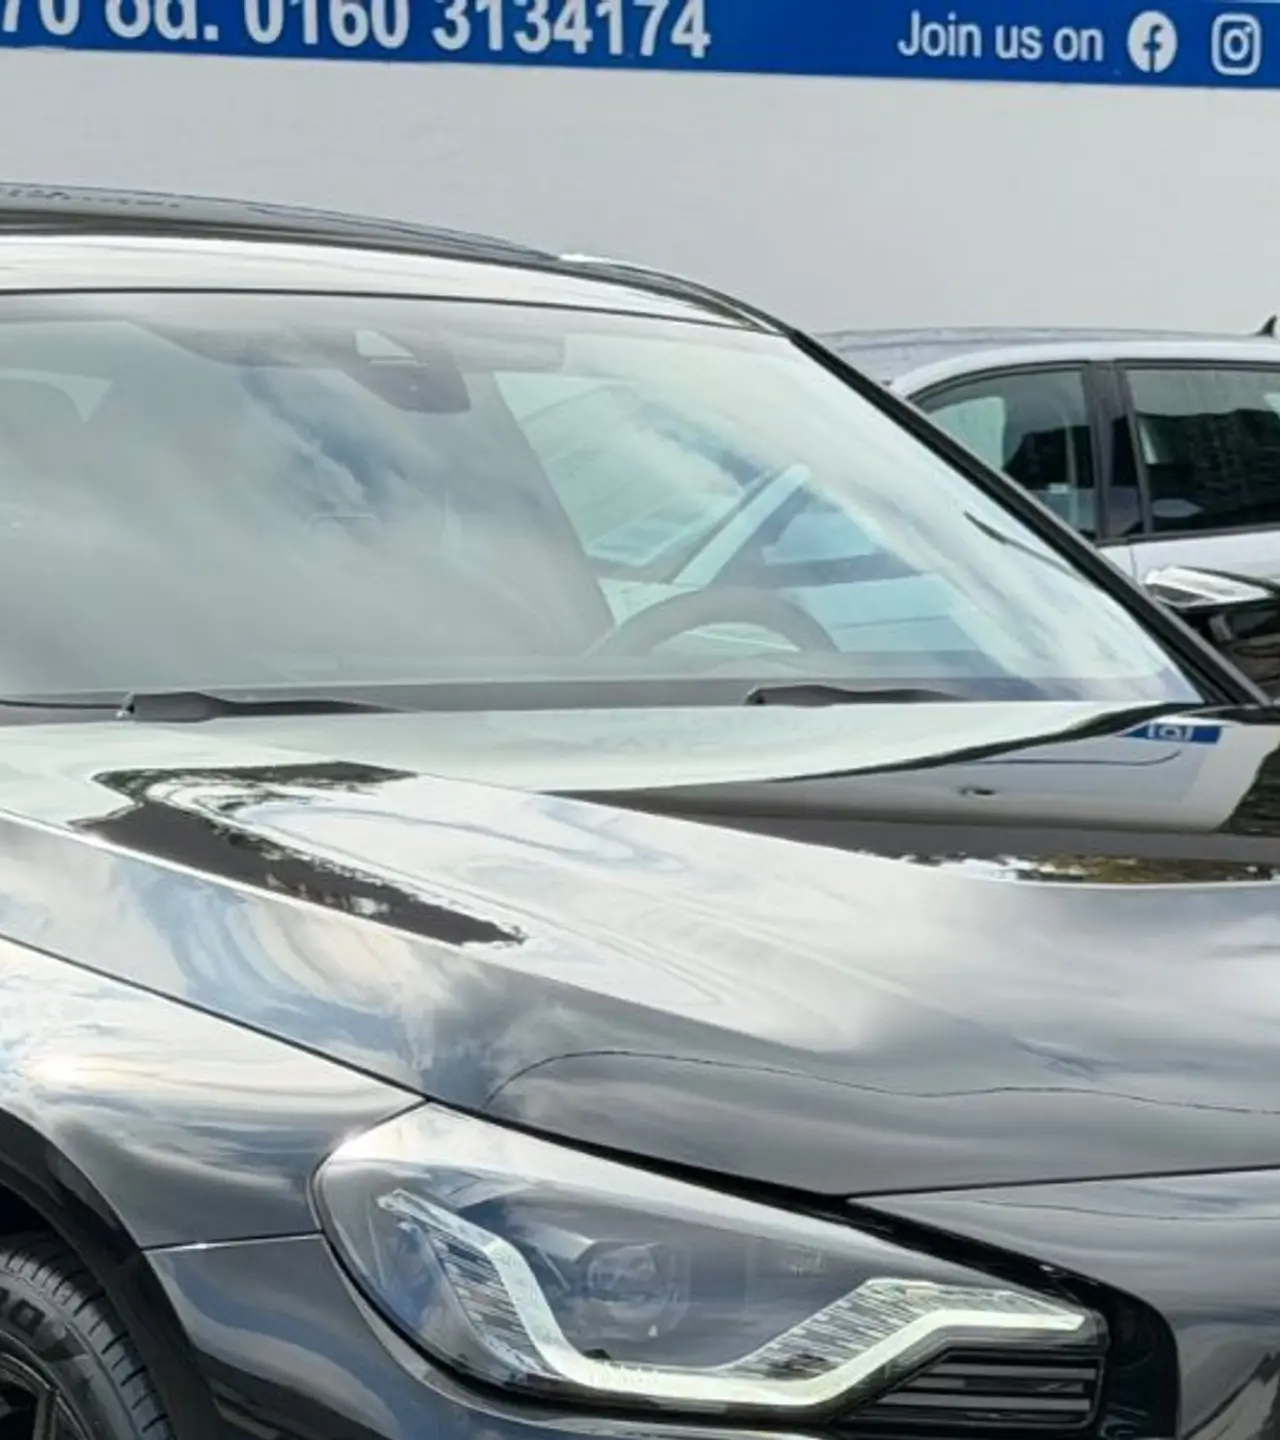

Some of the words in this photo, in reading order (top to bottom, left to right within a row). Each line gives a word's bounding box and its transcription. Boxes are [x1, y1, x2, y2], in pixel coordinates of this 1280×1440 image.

[106, 0, 218, 40] od.
[245, 0, 409, 48] 0160
[433, 0, 711, 57] 3134174
[898, 10, 982, 58] Join
[995, 26, 1043, 60] us
[1054, 27, 1104, 62] on
